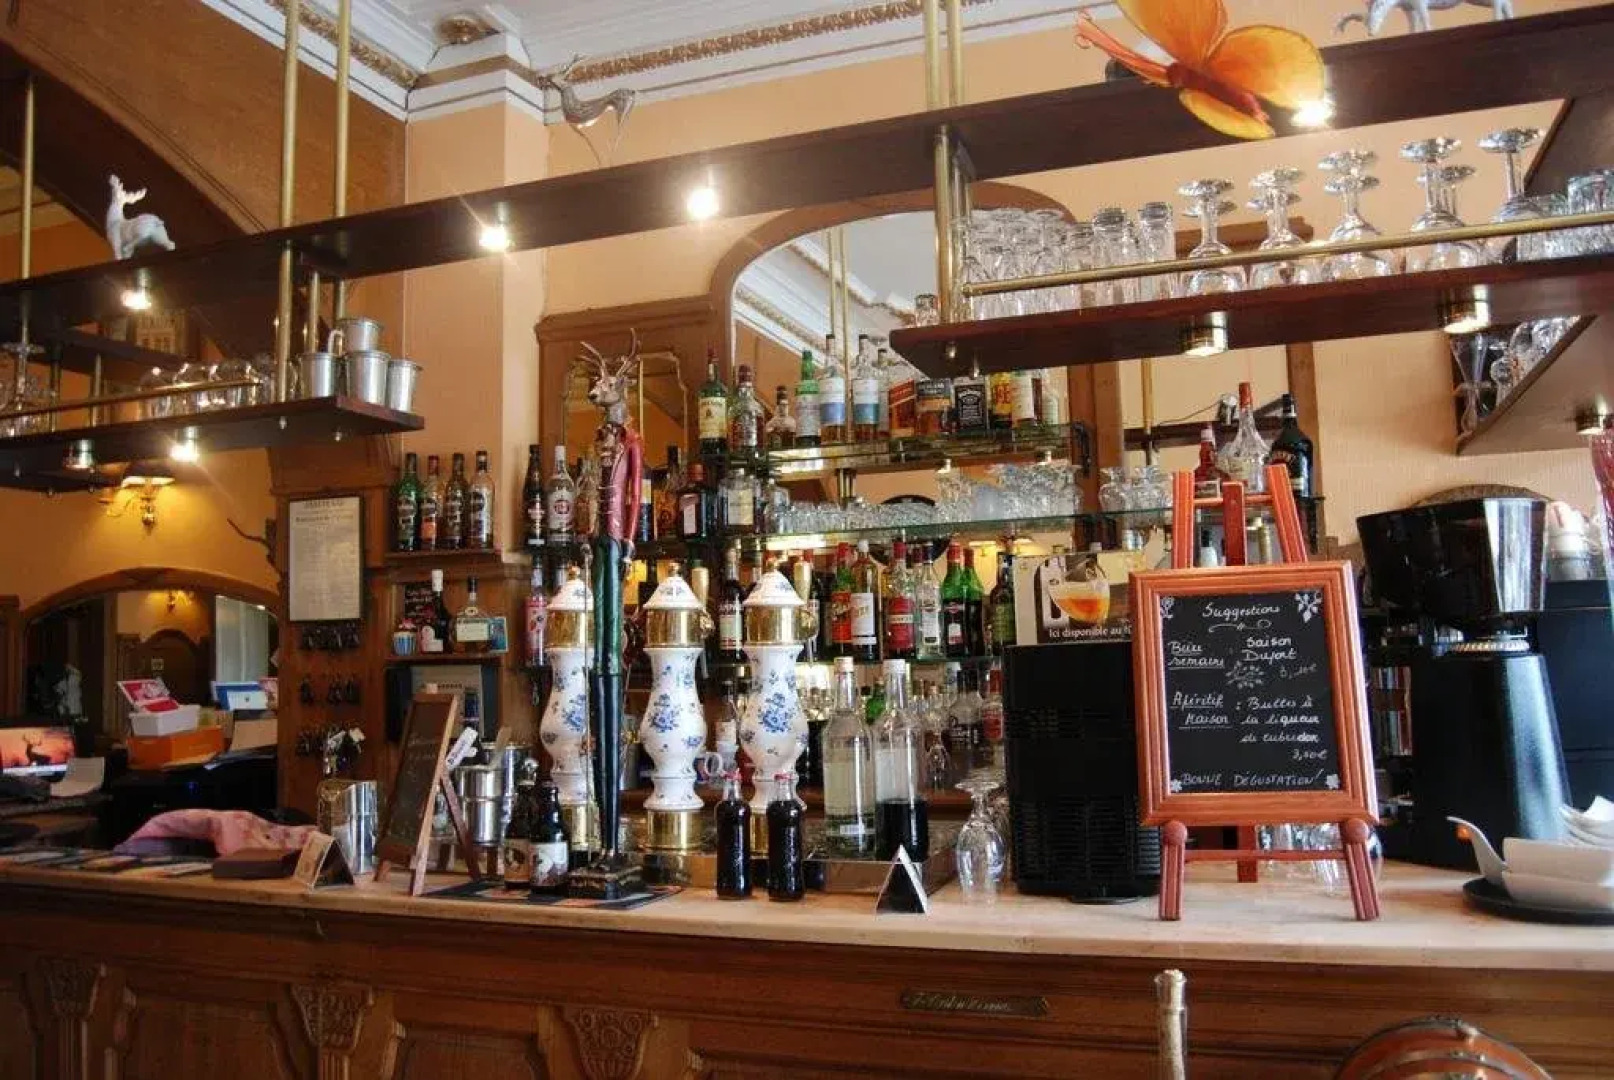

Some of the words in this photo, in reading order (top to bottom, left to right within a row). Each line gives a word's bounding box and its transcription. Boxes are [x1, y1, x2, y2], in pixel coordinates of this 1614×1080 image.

[1202, 602, 1280, 621] Suggestions
[1049, 628, 1060, 638] Ici
[1062, 626, 1108, 638] disponible
[1246, 635, 1292, 648] Saison
[1248, 696, 1297, 710] Bulles
